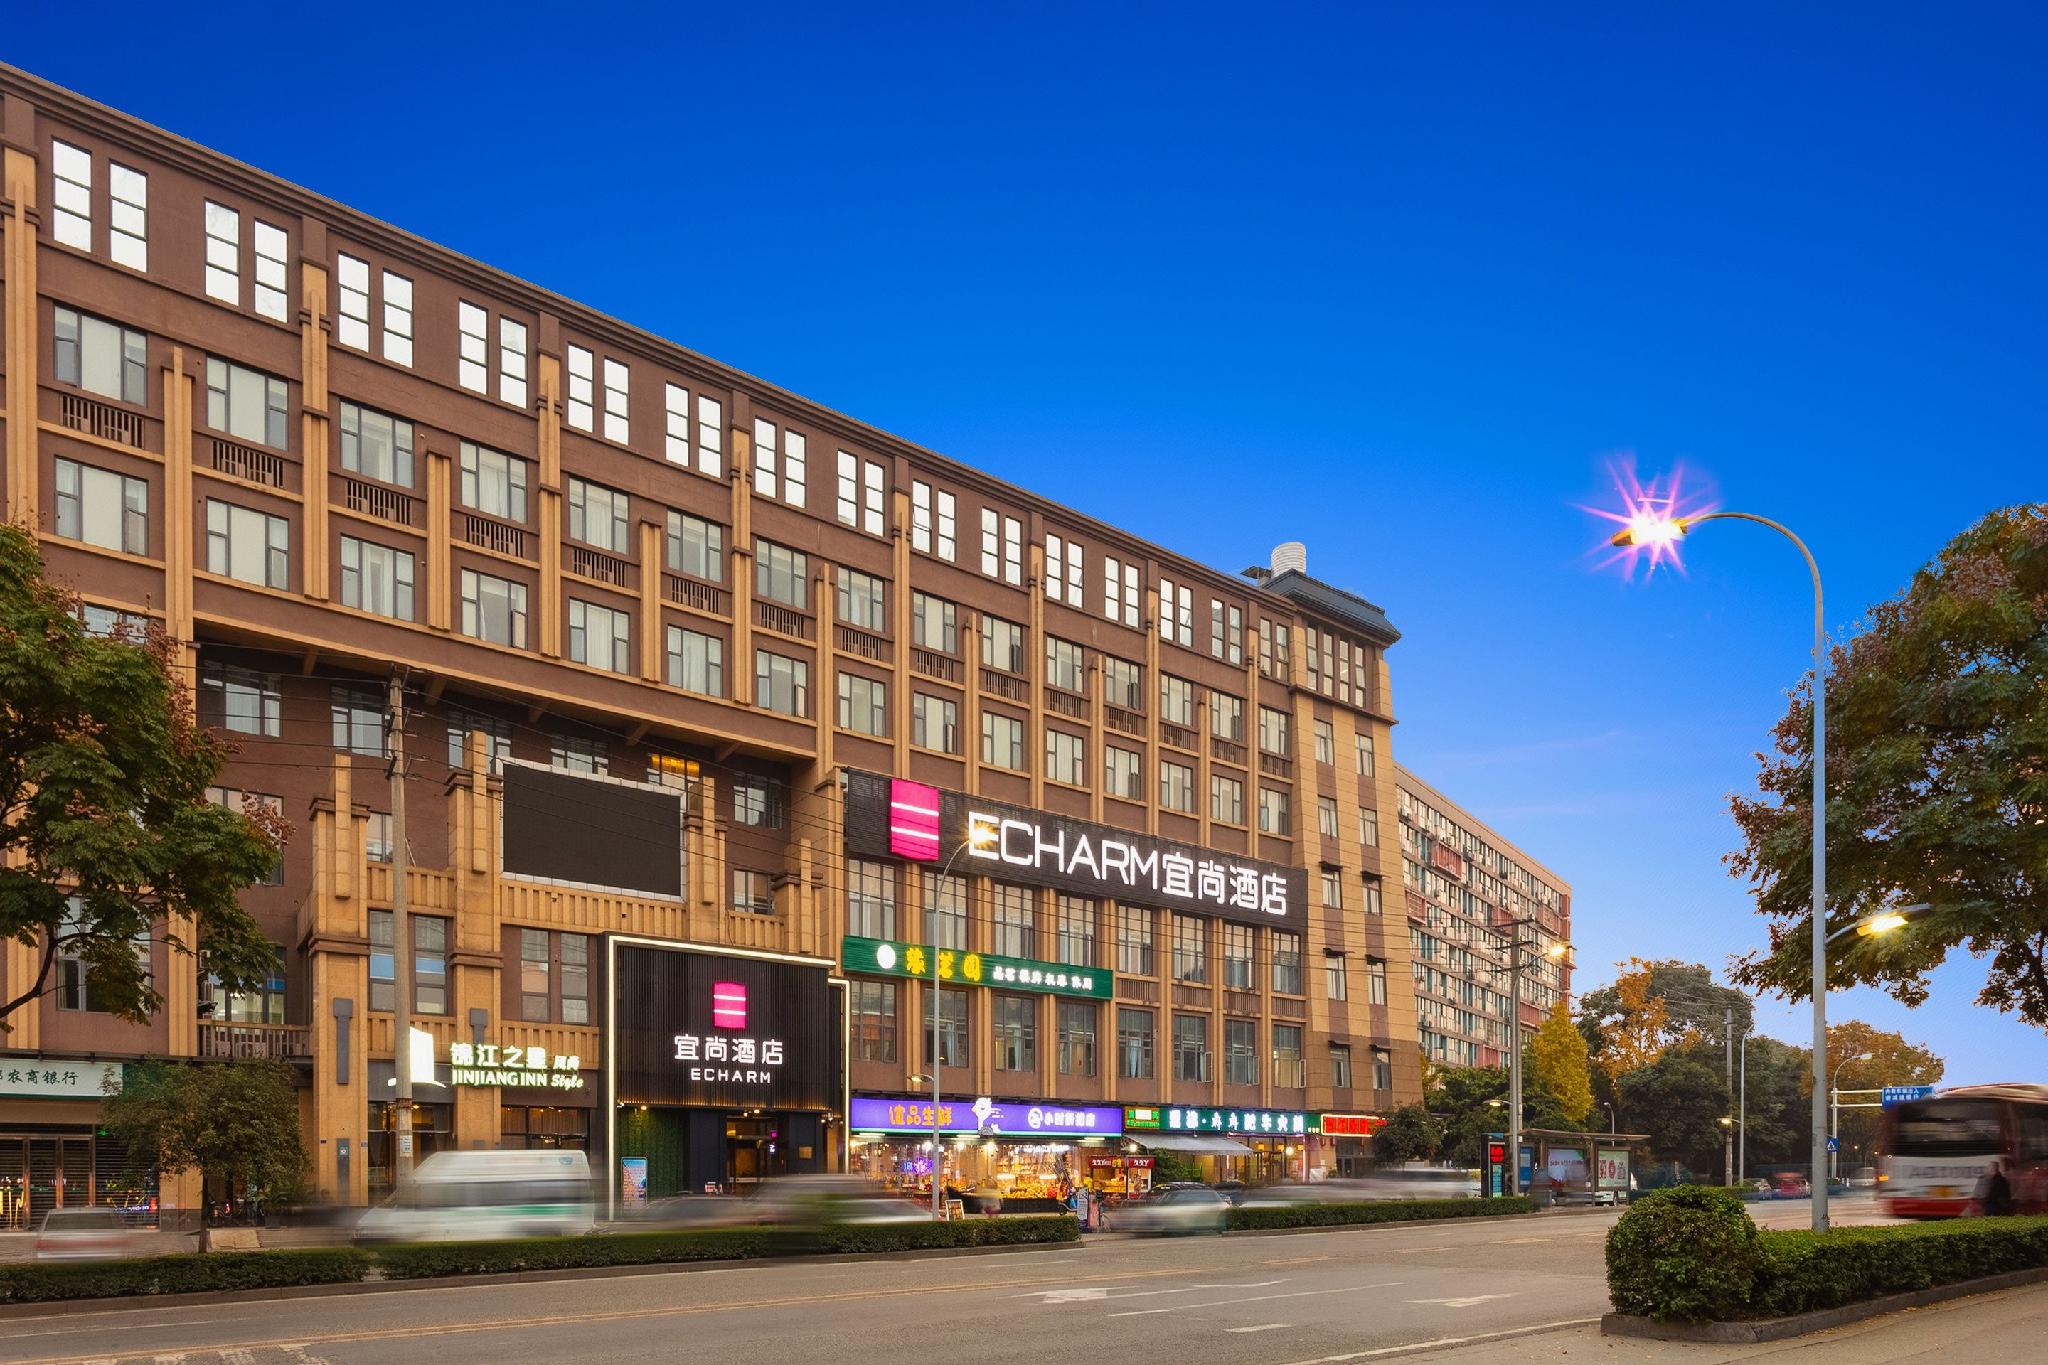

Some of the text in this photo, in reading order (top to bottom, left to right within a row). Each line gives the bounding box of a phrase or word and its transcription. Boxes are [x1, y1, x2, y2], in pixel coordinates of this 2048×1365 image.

[968, 811, 1287, 915] ECHARM 宜尚酒店
[674, 1033, 782, 1064] 宜尚酒店
[0, 1068, 79, 1086] 农商银行
[452, 1068, 584, 1091] JINJIANG INN Style
[691, 1068, 770, 1083] ECHARM
